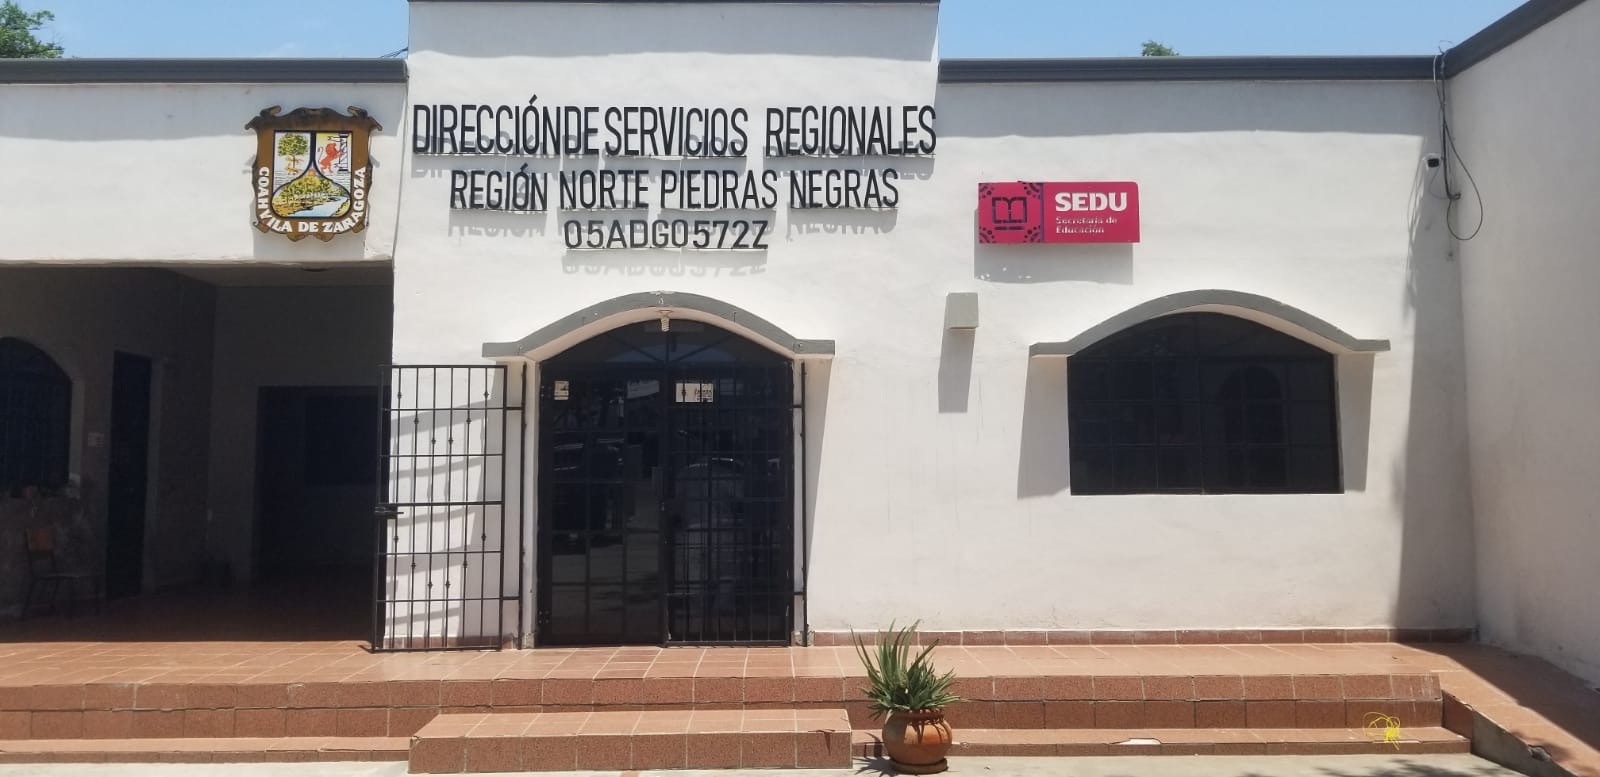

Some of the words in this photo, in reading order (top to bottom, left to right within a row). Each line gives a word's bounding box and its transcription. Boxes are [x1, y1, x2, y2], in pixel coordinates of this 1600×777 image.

[413, 94, 560, 155] DIRECCIÓN
[564, 106, 599, 155] DE
[605, 106, 748, 156] SERVICIOS
[766, 105, 937, 156] REGIONALES
[298, 221, 319, 233] DE
[322, 166, 367, 233] ZARAGOZA
[450, 162, 547, 210] REGIÓN
[560, 170, 649, 209] NORTE
[661, 170, 778, 209] PIEDRAS
[791, 168, 899, 209] NEGRAS
[1055, 192, 1128, 212] SEDU
[1055, 224, 1105, 234] Educación
[1106, 216, 1118, 225] de
